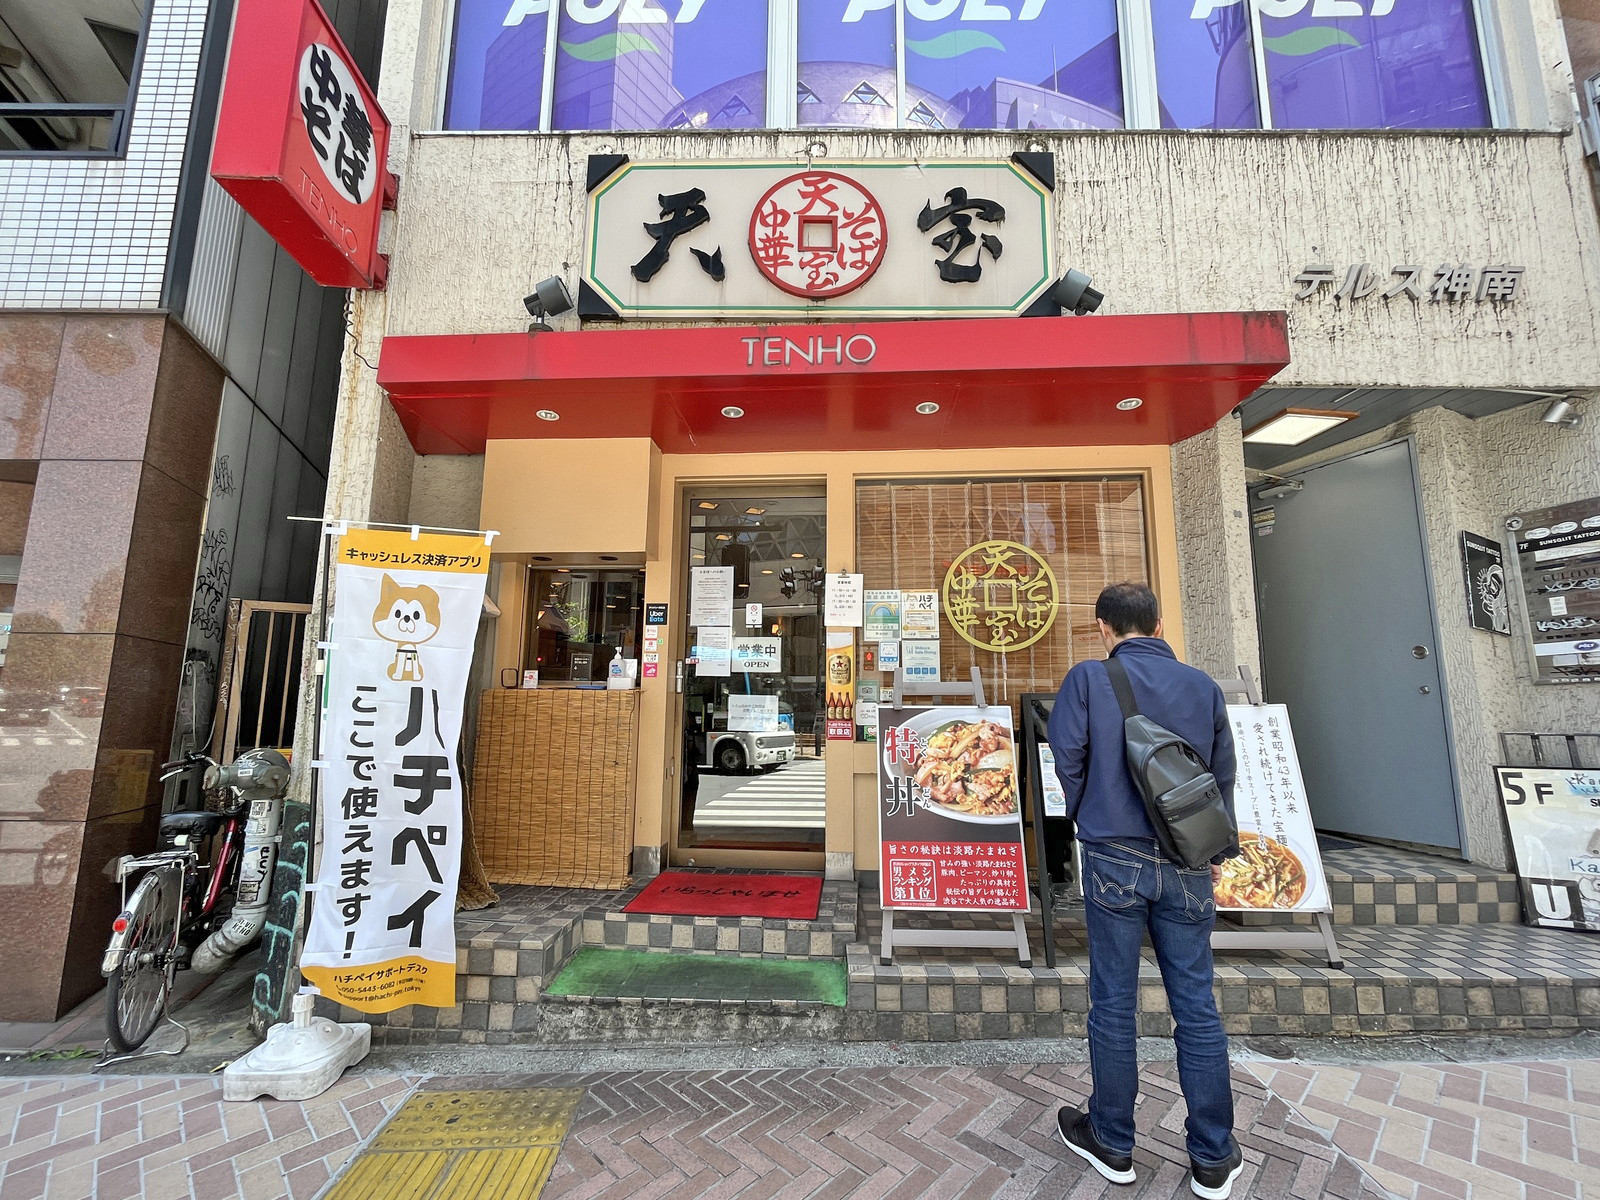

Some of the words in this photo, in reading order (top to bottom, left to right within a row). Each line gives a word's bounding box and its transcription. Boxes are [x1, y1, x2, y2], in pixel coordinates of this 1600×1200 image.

[298, 166, 359, 252] TENHO
[756, 200, 795, 276] 中華
[836, 201, 881, 271] そば
[1293, 262, 1526, 301] テルス神南
[741, 333, 878, 366] TENHO
[345, 547, 482, 568] キャッシュレス決済アプリ
[1519, 543, 1529, 551] 7F
[918, 594, 933, 602] ハチ
[918, 602, 933, 610] ペイ
[950, 564, 981, 634] 中華
[1016, 567, 1053, 629] そば
[737, 644, 776, 658] 営業中
[1267, 716, 1299, 815] 創業昭和43年以来
[387, 686, 452, 949] ハチペイ
[888, 844, 1018, 857] 旨さの秘訣は淡路たまねぎ
[893, 877, 932, 887] ランキング
[960, 878, 1017, 887] たっぷりの具材と
[894, 887, 931, 900] 第1位
[333, 962, 428, 984] ハチペイサポートデスク
